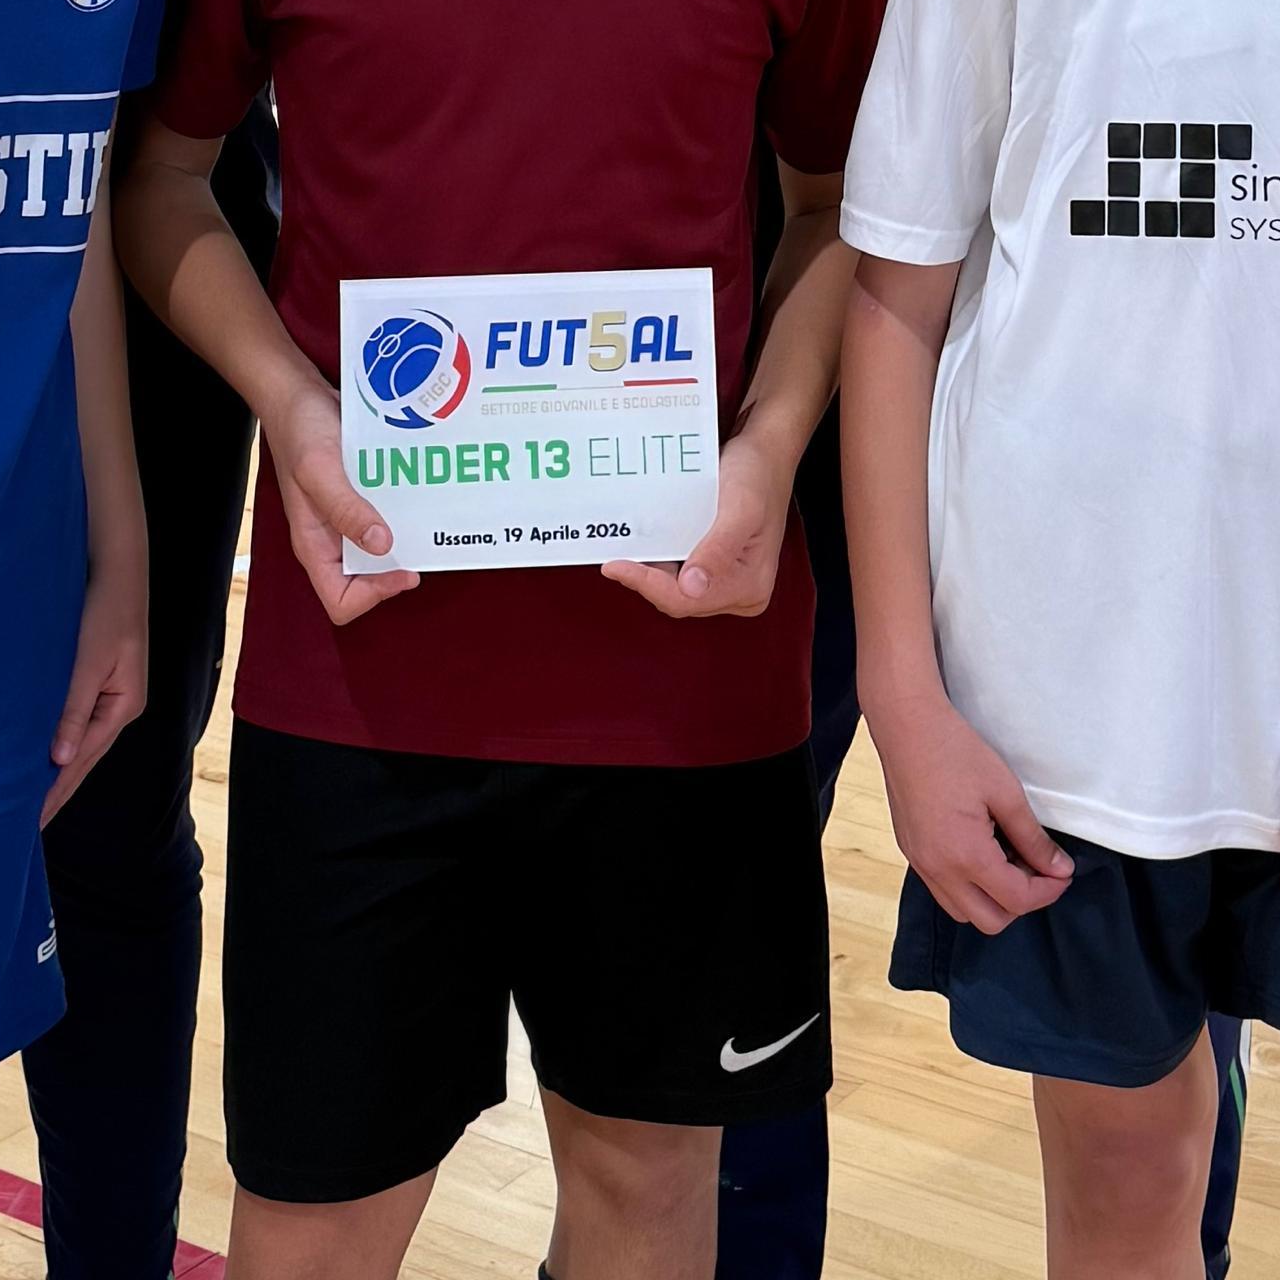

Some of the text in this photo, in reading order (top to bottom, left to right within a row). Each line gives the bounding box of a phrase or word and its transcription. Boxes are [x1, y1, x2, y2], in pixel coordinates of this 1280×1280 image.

[485, 310, 693, 372] FUT5AL
[418, 371, 454, 409] FIGC
[480, 394, 701, 416] SETTORE GIOVANILE E SCOLASTICO
[358, 433, 702, 488] UNDER 13 ELITE
[433, 522, 631, 546] Ussana, 19 Aprile 2026
